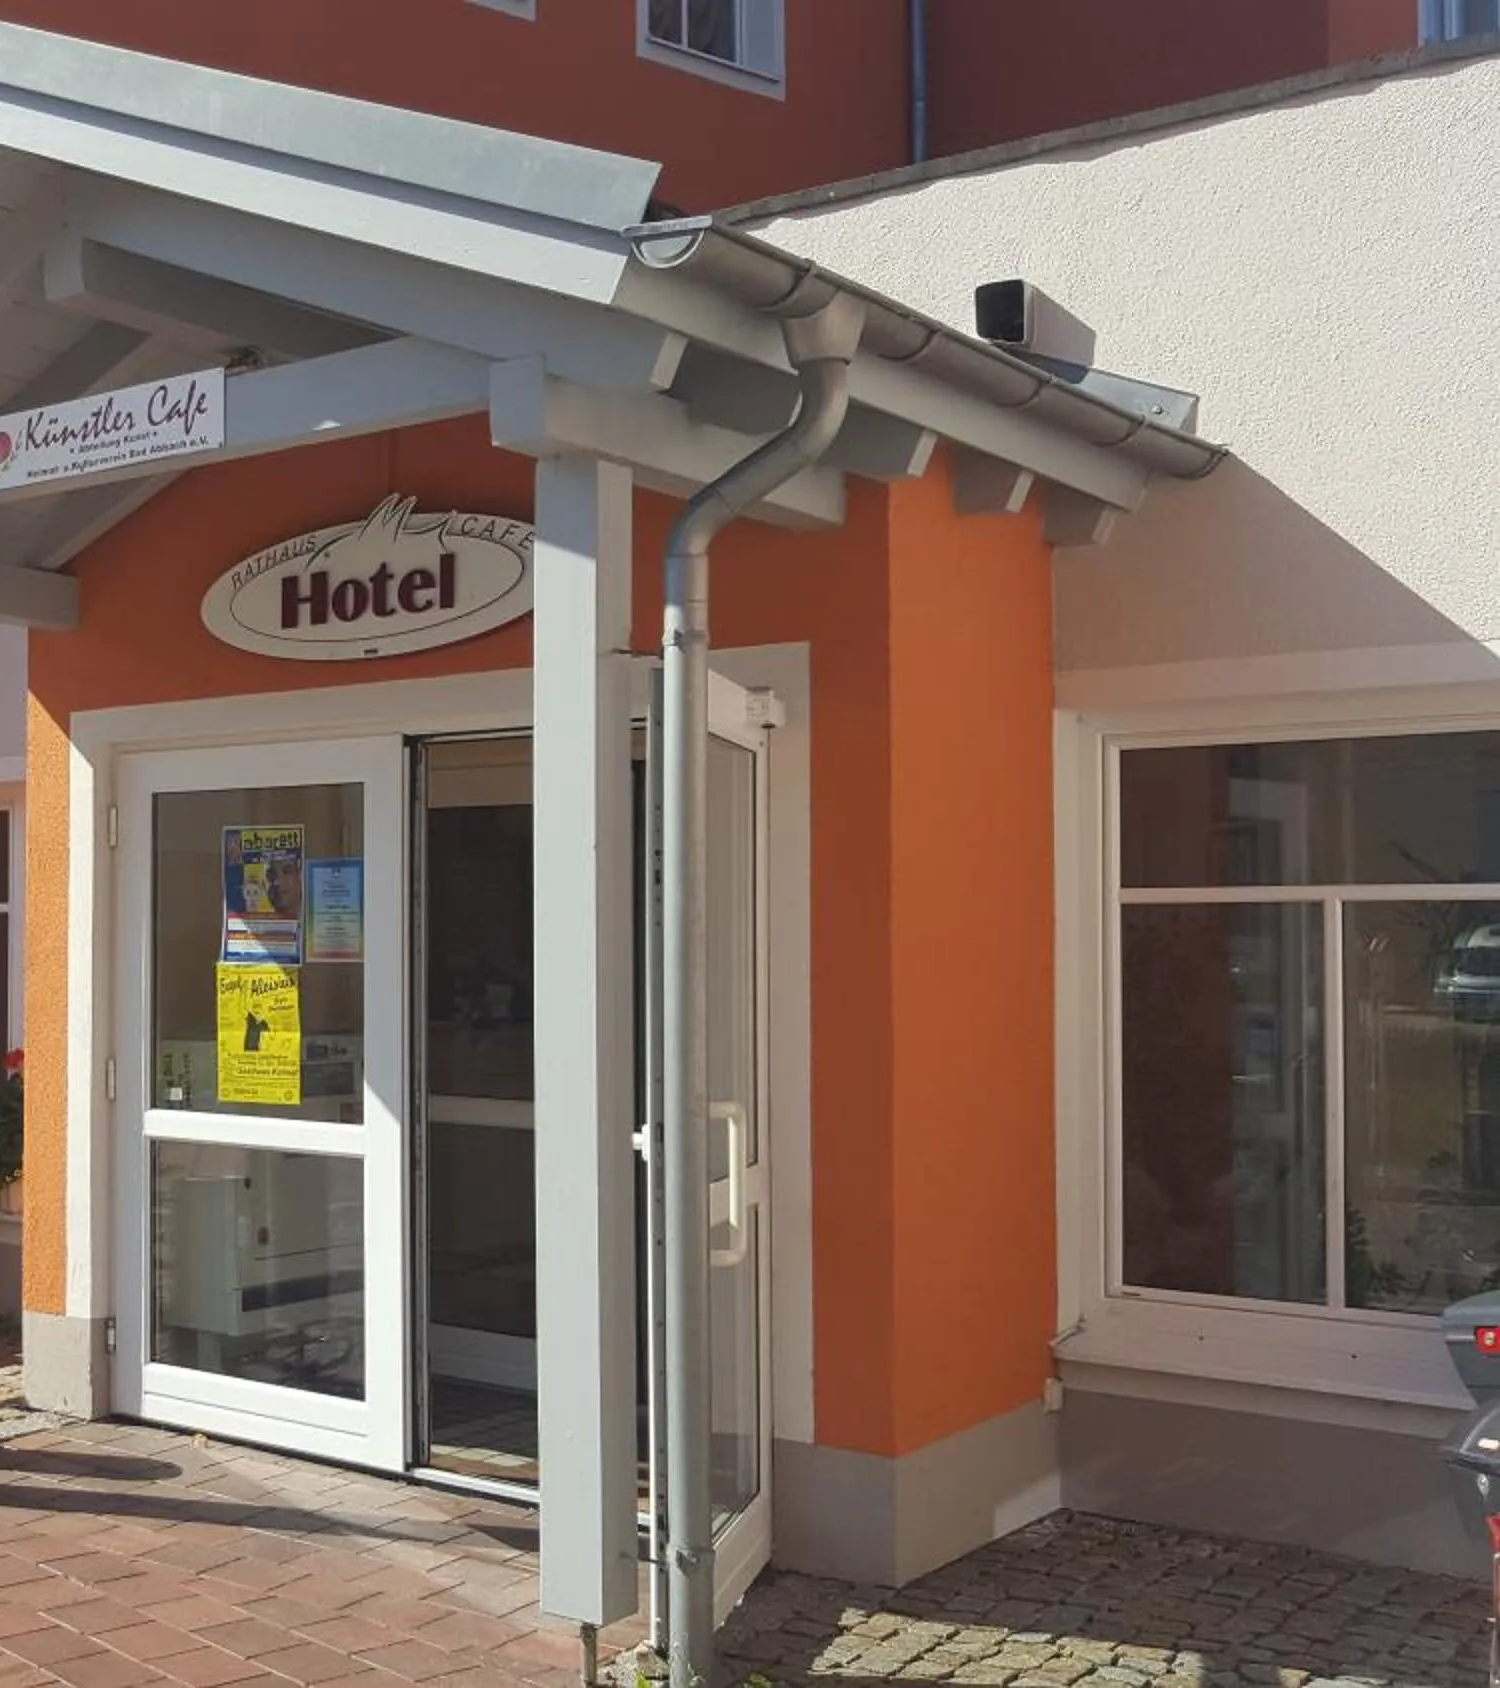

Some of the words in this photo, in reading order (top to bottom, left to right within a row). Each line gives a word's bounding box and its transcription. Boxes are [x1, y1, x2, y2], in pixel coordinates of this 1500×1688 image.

[25, 396, 136, 452] Künstler
[231, 533, 318, 591] RATHAUS
[281, 553, 455, 630] Hotel
